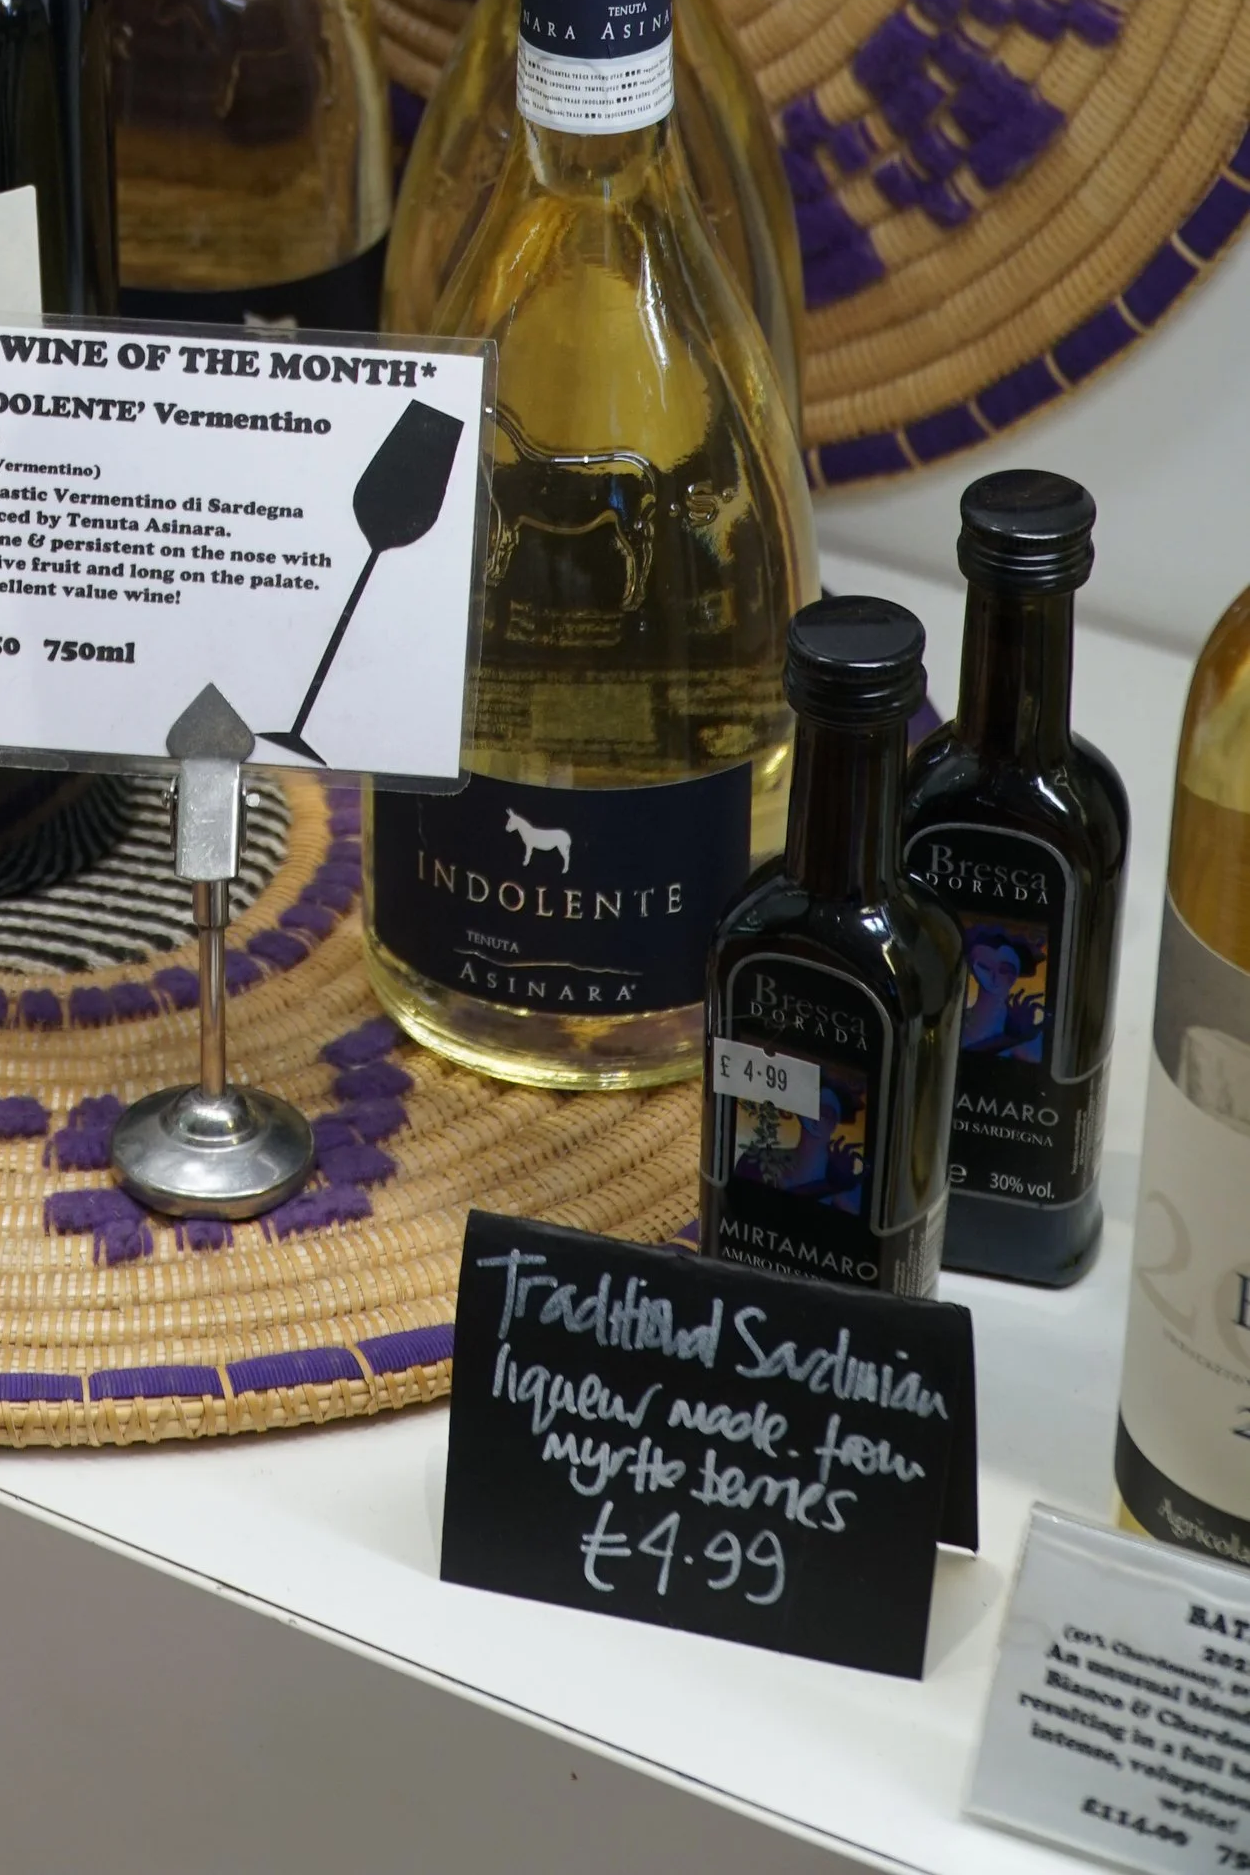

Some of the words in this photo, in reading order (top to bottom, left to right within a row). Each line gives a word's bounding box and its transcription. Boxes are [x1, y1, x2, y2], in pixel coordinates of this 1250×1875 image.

[608, 2, 648, 17] TENUTA
[117, 342, 171, 372] OF
[178, 346, 261, 378] THE
[153, 401, 332, 435] Vermentino
[53, 487, 177, 510] Vermentino
[181, 496, 202, 512] di
[207, 498, 304, 521] Sardegna
[36, 510, 62, 530] by
[66, 512, 139, 532] Tenuta
[144, 517, 231, 538] Asinara.
[27, 532, 46, 549] &
[50, 537, 155, 556] persistent
[159, 545, 185, 558] on
[191, 544, 225, 561] the
[230, 550, 277, 564] nose
[281, 551, 332, 568] with
[31, 556, 81, 575] fruit
[86, 562, 125, 578] and
[129, 563, 175, 585] long
[179, 570, 205, 583] on
[211, 569, 245, 586] the
[249, 573, 319, 591] palate.
[61, 584, 119, 600] value
[123, 587, 181, 605] wine!
[43, 638, 136, 664] 750ml
[418, 849, 683, 920] INDOLENTE
[929, 843, 1047, 891] Bresca
[466, 929, 521, 954] TENUTA
[753, 973, 866, 1037] Bresca
[751, 1001, 868, 1052] DORADA
[972, 1121, 1054, 1147] SARDEGNA
[989, 1173, 1024, 1194] 30%
[1027, 1178, 1056, 1199] vol.
[719, 1216, 879, 1282] MIRTAMARO
[721, 1245, 772, 1274] AMARO
[734, 1305, 949, 1420] Sardinian
[492, 1342, 663, 1435] liqueur
[816, 1413, 925, 1483] from
[543, 1431, 687, 1497] myrtle
[690, 1449, 858, 1533] berries
[1046, 1642, 1080, 1668] An
[1018, 1690, 1127, 1744] resulting
